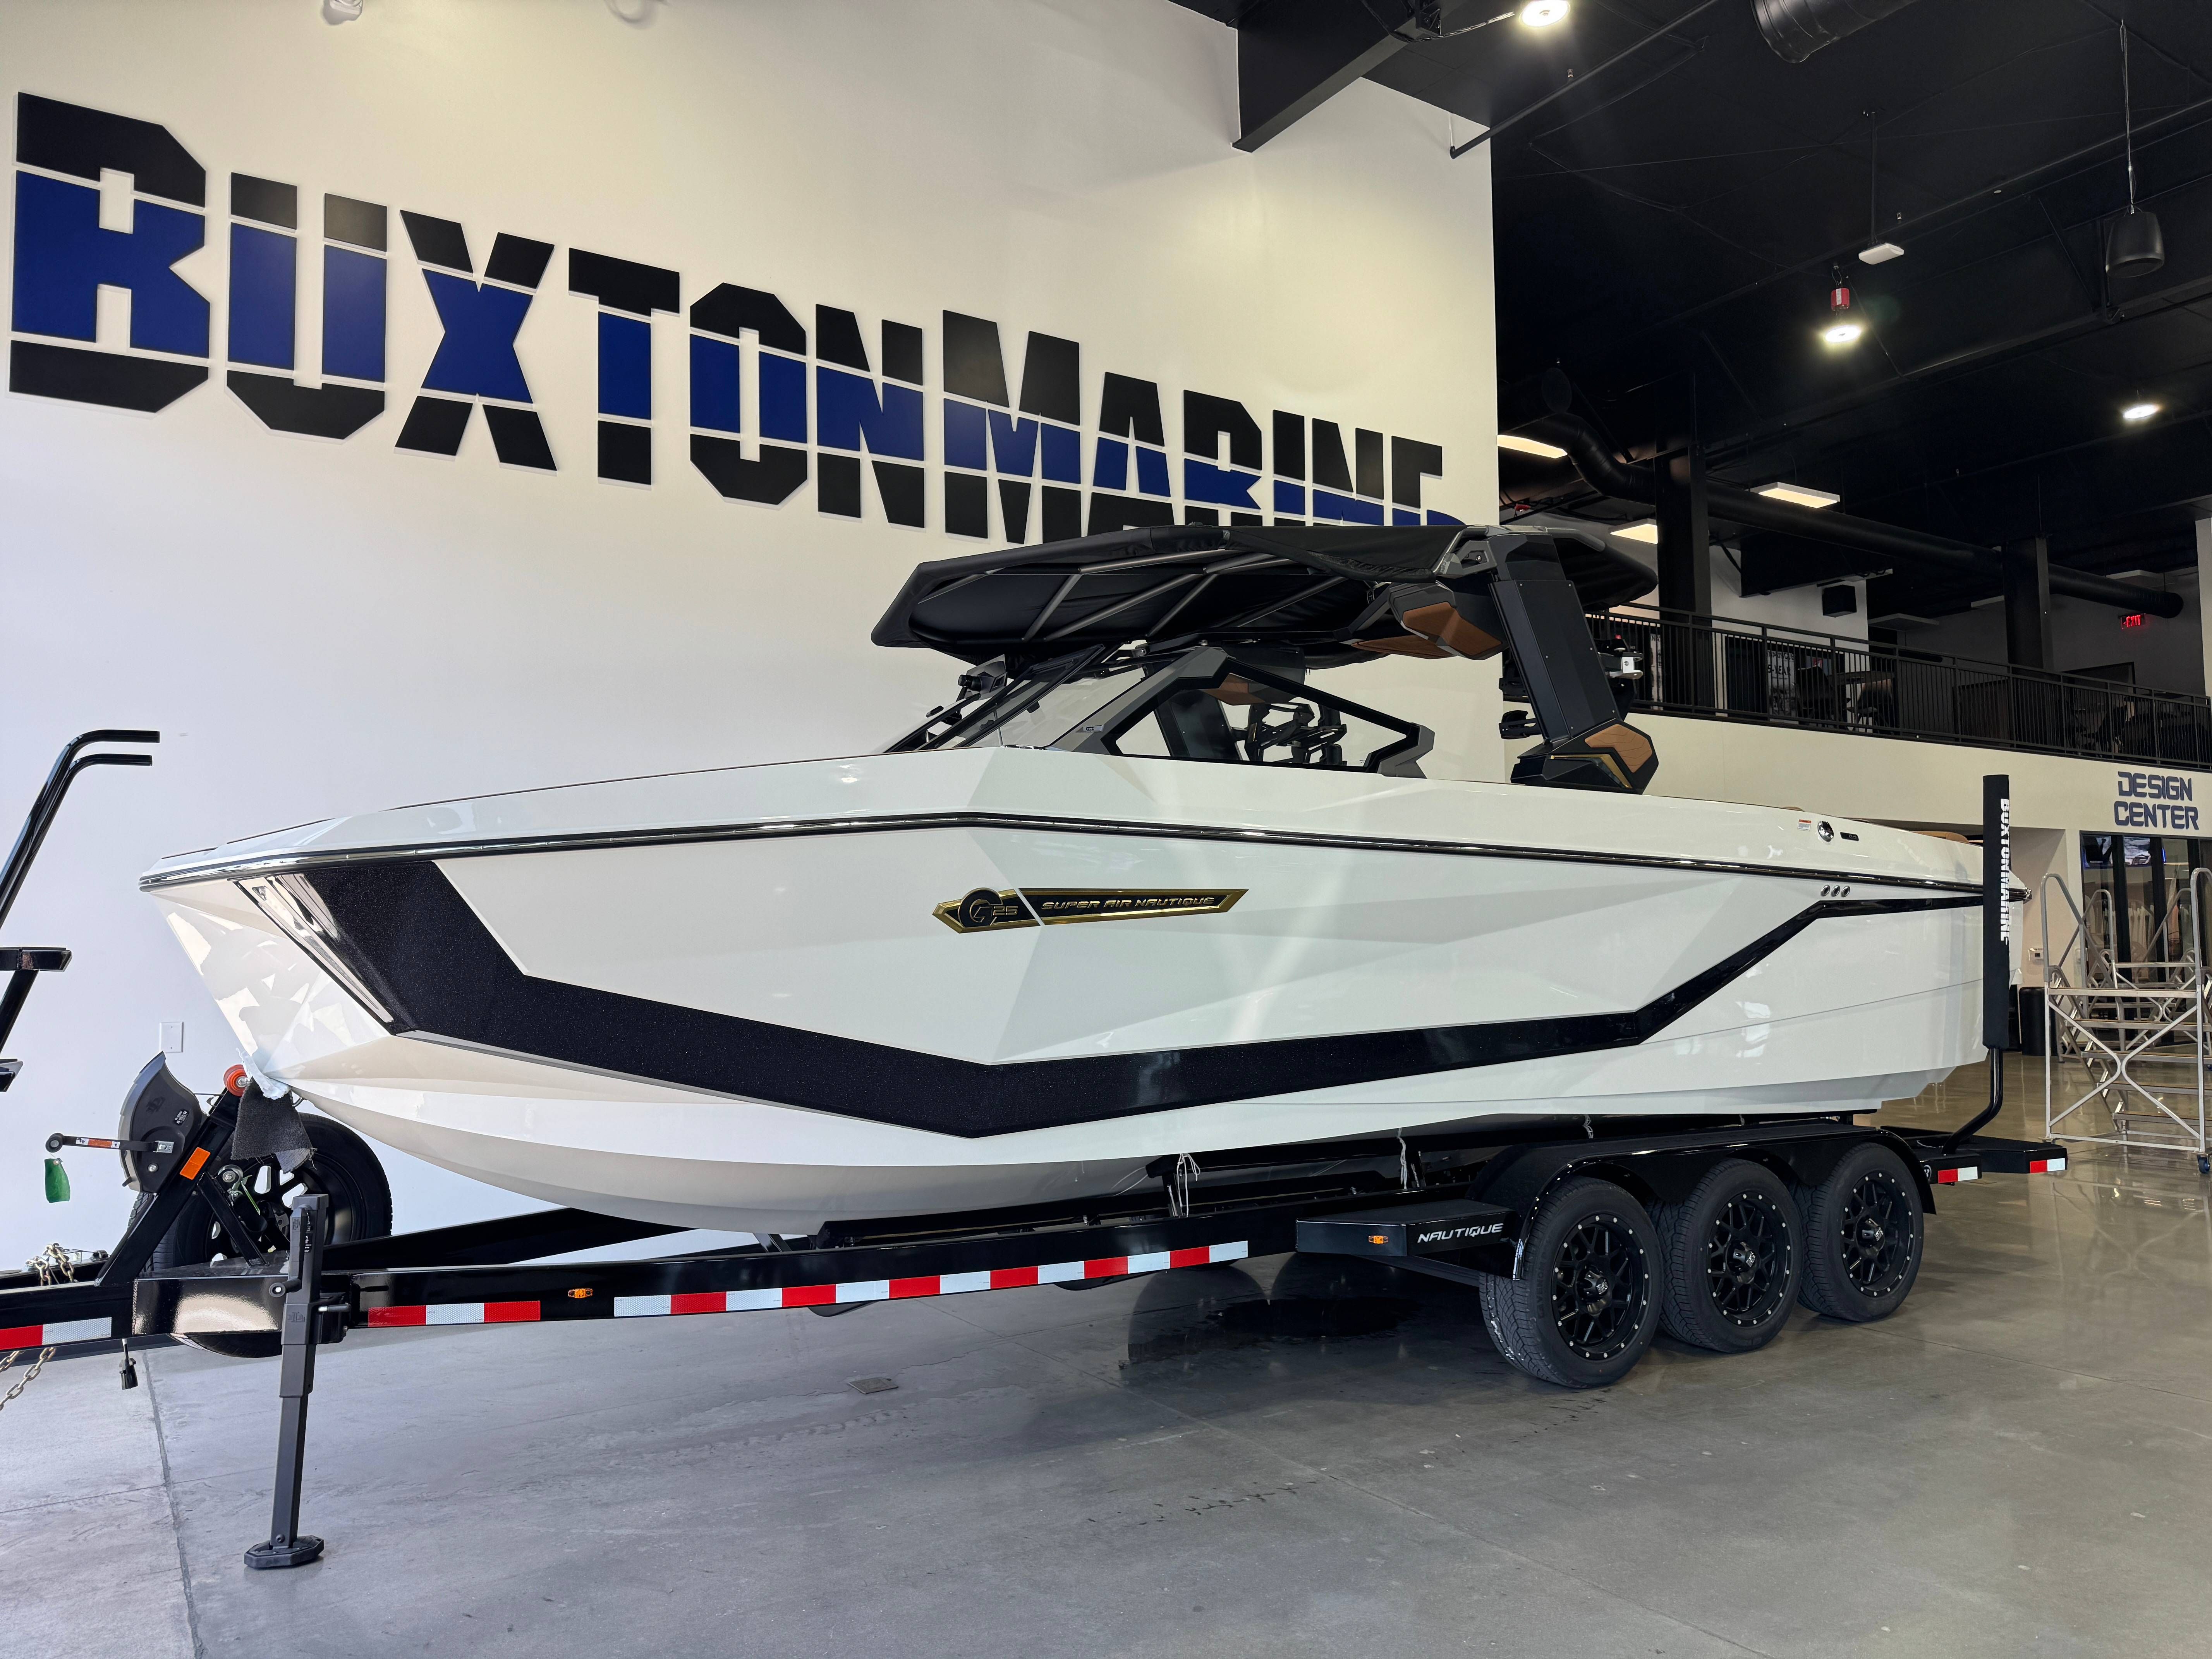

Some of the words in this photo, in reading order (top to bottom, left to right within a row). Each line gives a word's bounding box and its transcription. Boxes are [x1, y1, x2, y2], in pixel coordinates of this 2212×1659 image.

[2126, 615, 2141, 627] EXIT
[2118, 771, 2193, 801] DESIGN
[2114, 800, 2199, 830] CENTER
[1041, 900, 1100, 910] SUPER
[1103, 899, 1132, 908] AIR
[1135, 897, 1215, 907] NAUTIQUE
[1417, 1223, 1504, 1243] NAUTIQUE
